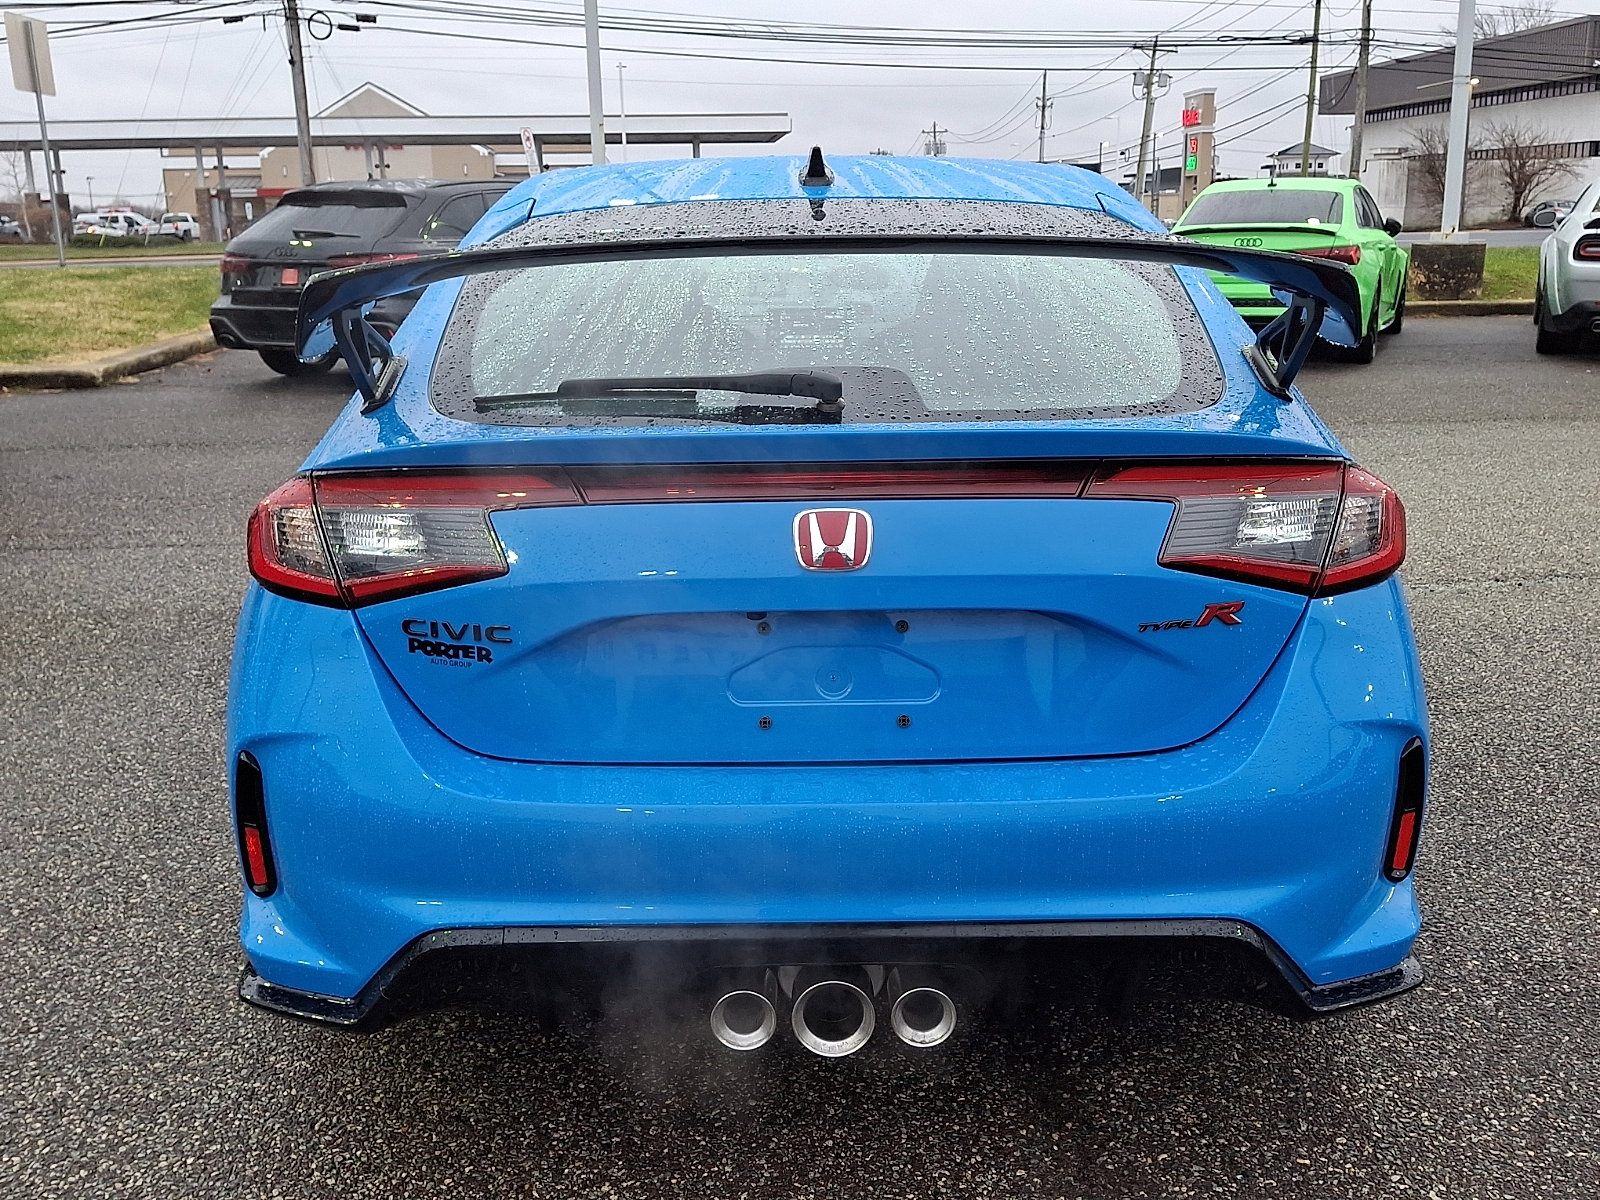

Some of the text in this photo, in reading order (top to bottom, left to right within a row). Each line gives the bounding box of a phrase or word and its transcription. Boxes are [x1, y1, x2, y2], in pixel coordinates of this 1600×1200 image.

[1138, 600, 1246, 632] TYPE R
[401, 618, 513, 643] CIVIC
[407, 637, 493, 664] PORTER
[430, 657, 473, 668] AUTO GROUP
